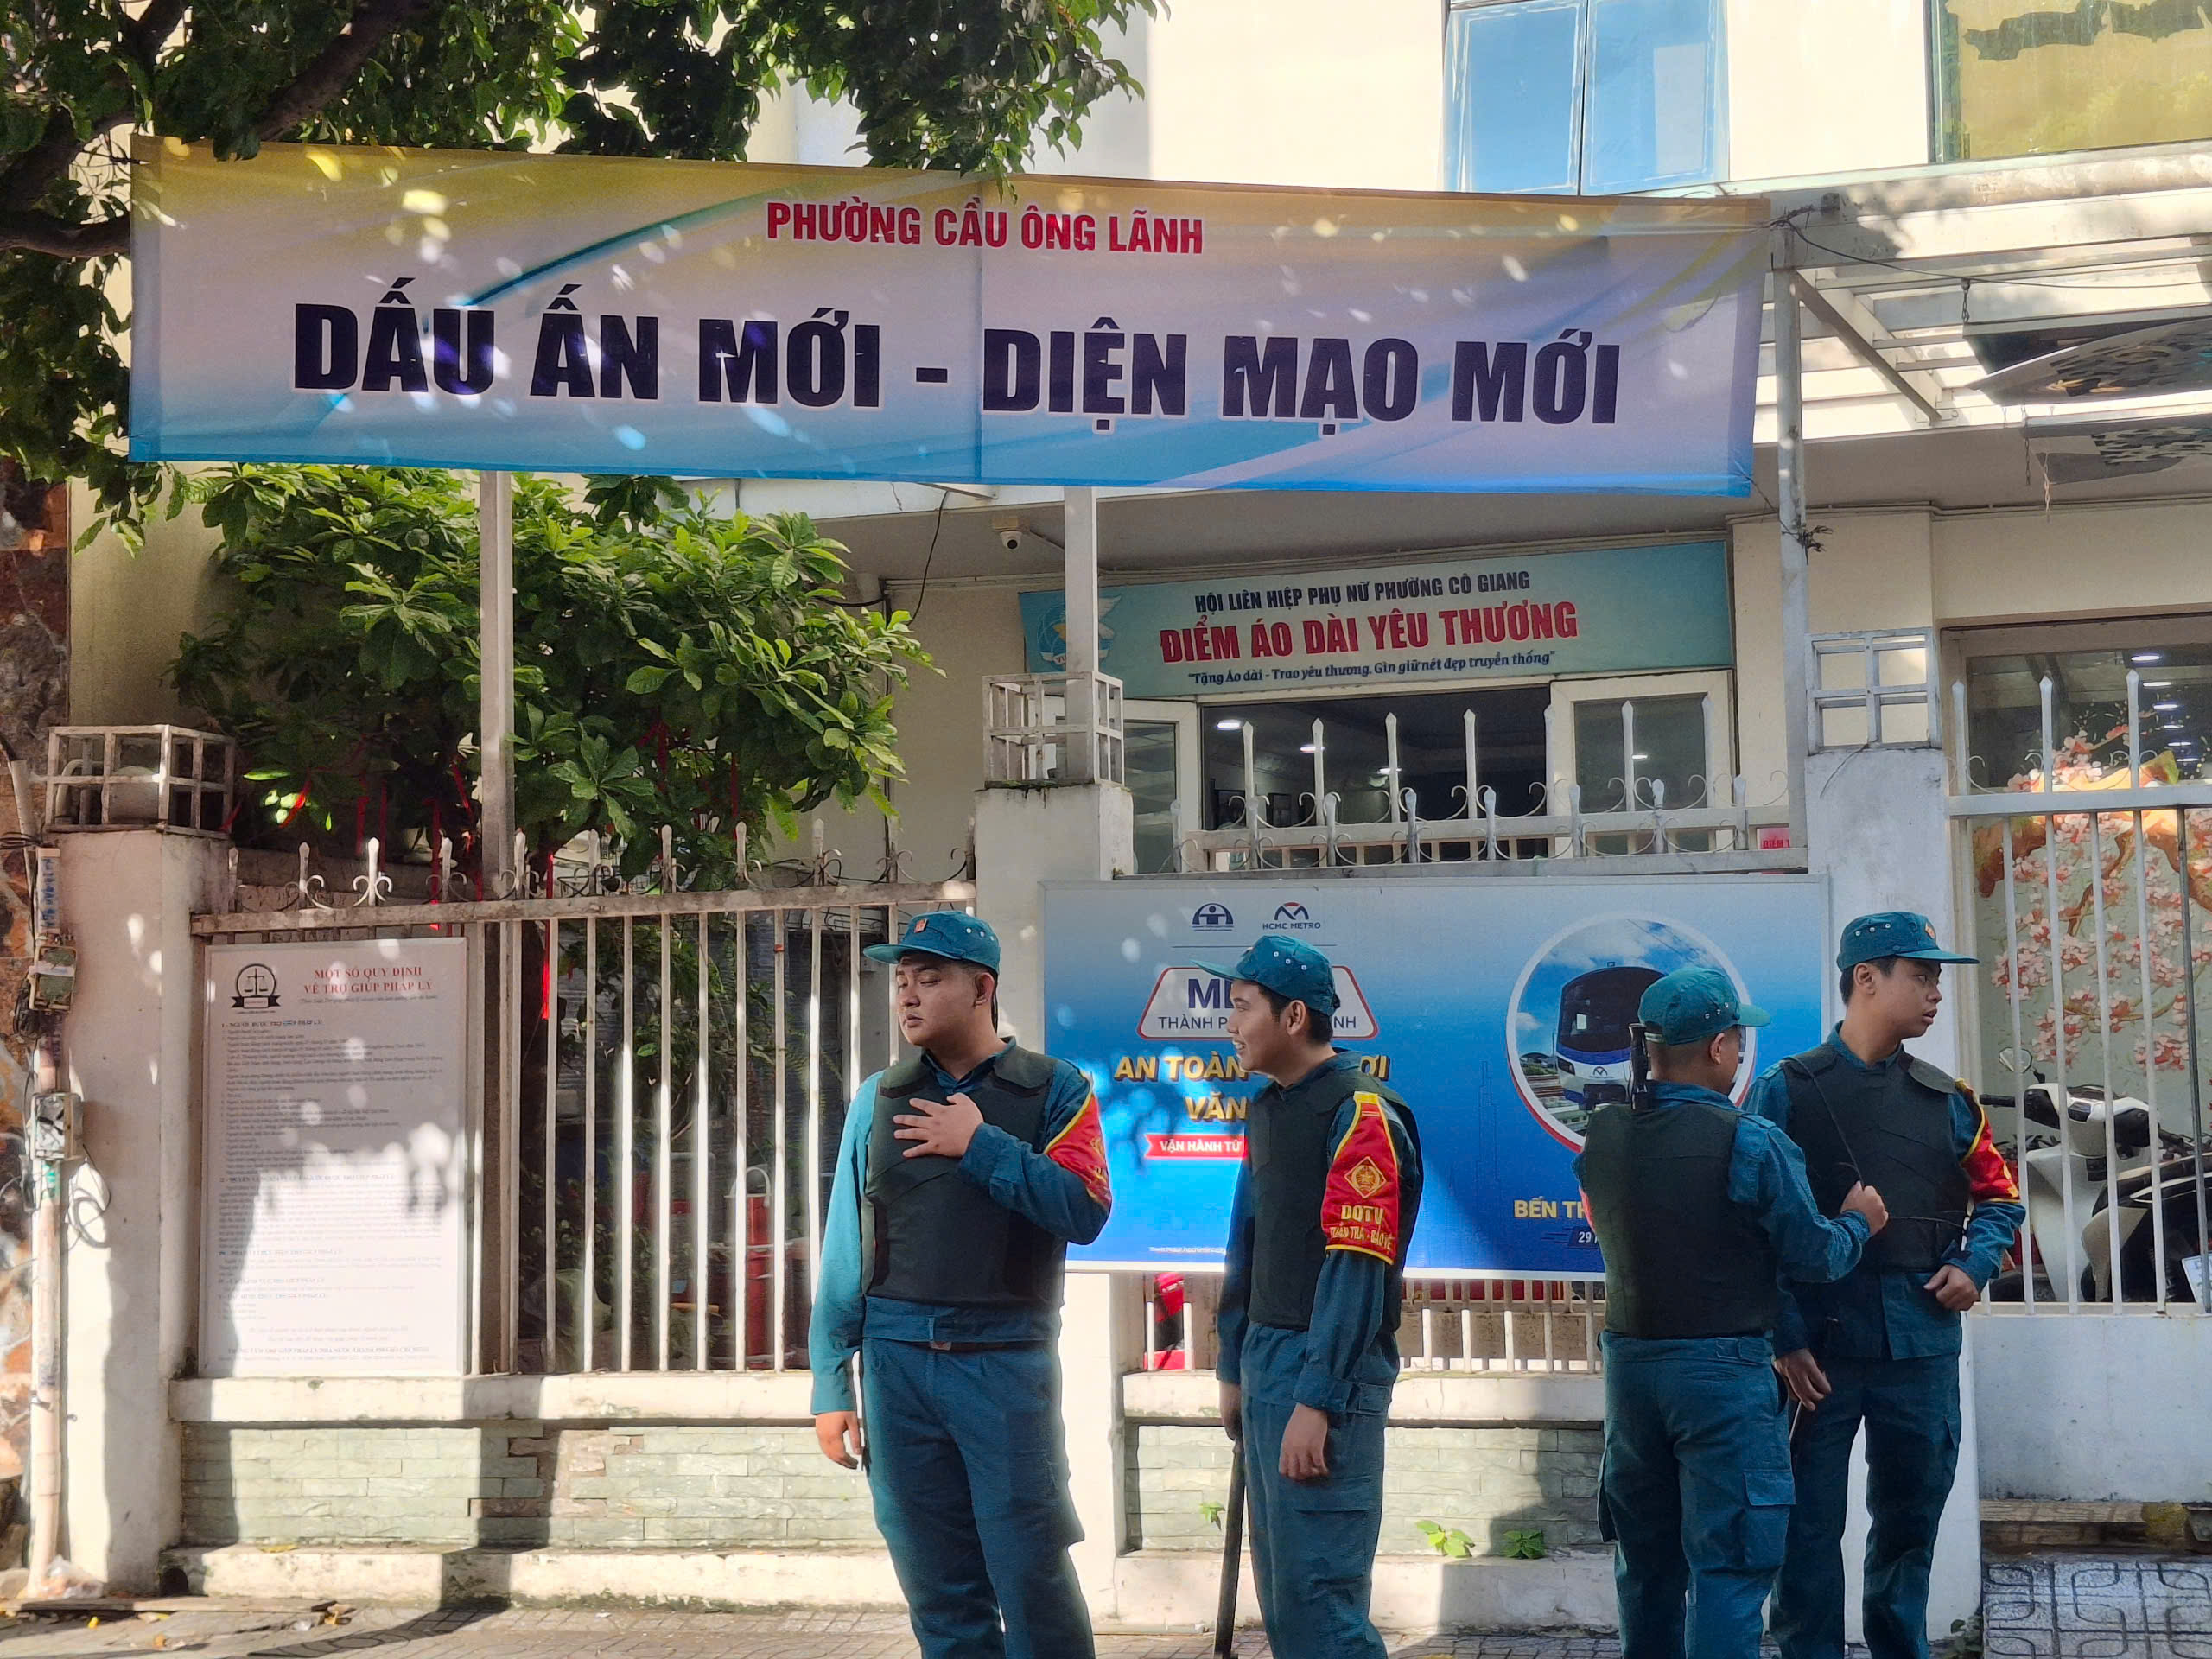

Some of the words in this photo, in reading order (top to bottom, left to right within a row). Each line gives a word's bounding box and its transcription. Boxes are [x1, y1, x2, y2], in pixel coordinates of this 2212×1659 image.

[767, 196, 920, 244] PHƯỜNG
[935, 198, 1007, 247] CẦU
[1021, 205, 1096, 251] ÔNG
[1109, 210, 1203, 254] LÃNH
[294, 277, 495, 396] DẤU
[530, 283, 658, 400] ẤN
[698, 308, 880, 408] MỚI
[916, 368, 947, 383] -
[982, 317, 1187, 432] DIỆN
[1223, 336, 1417, 436] MẠO
[1451, 328, 1620, 425] MỚI
[1195, 592, 1224, 615] HỘI
[1229, 590, 1262, 610] LIÊN
[1267, 587, 1302, 610] HIỆP
[1308, 586, 1341, 607] PHỤ
[1346, 581, 1370, 602] NỮ
[1375, 577, 1443, 601] PHƯỜNG
[1448, 573, 1471, 594] CÔ
[1478, 570, 1530, 592] GIANG
[1160, 614, 1241, 663] ĐIỂM
[1251, 618, 1293, 658] ÁO
[1303, 613, 1359, 654] DÀI
[1368, 608, 1428, 650] YÊU
[1439, 599, 1578, 645] THƯƠNG
[1272, 669, 1300, 681] Trao
[1444, 656, 1466, 672] đẹp
[1290, 921, 1321, 930] METRO
[1158, 1014, 1212, 1029] THÀNH
[1114, 1055, 1159, 1080] AN
[1163, 1049, 1247, 1080] TOÀN
[1184, 1090, 1248, 1122] VĂN
[1159, 1138, 1185, 1154] VẬN
[1187, 1139, 1222, 1153] HÀNH
[1513, 1195, 1557, 1218] BẾN
[1578, 1230, 1592, 1243] 29
